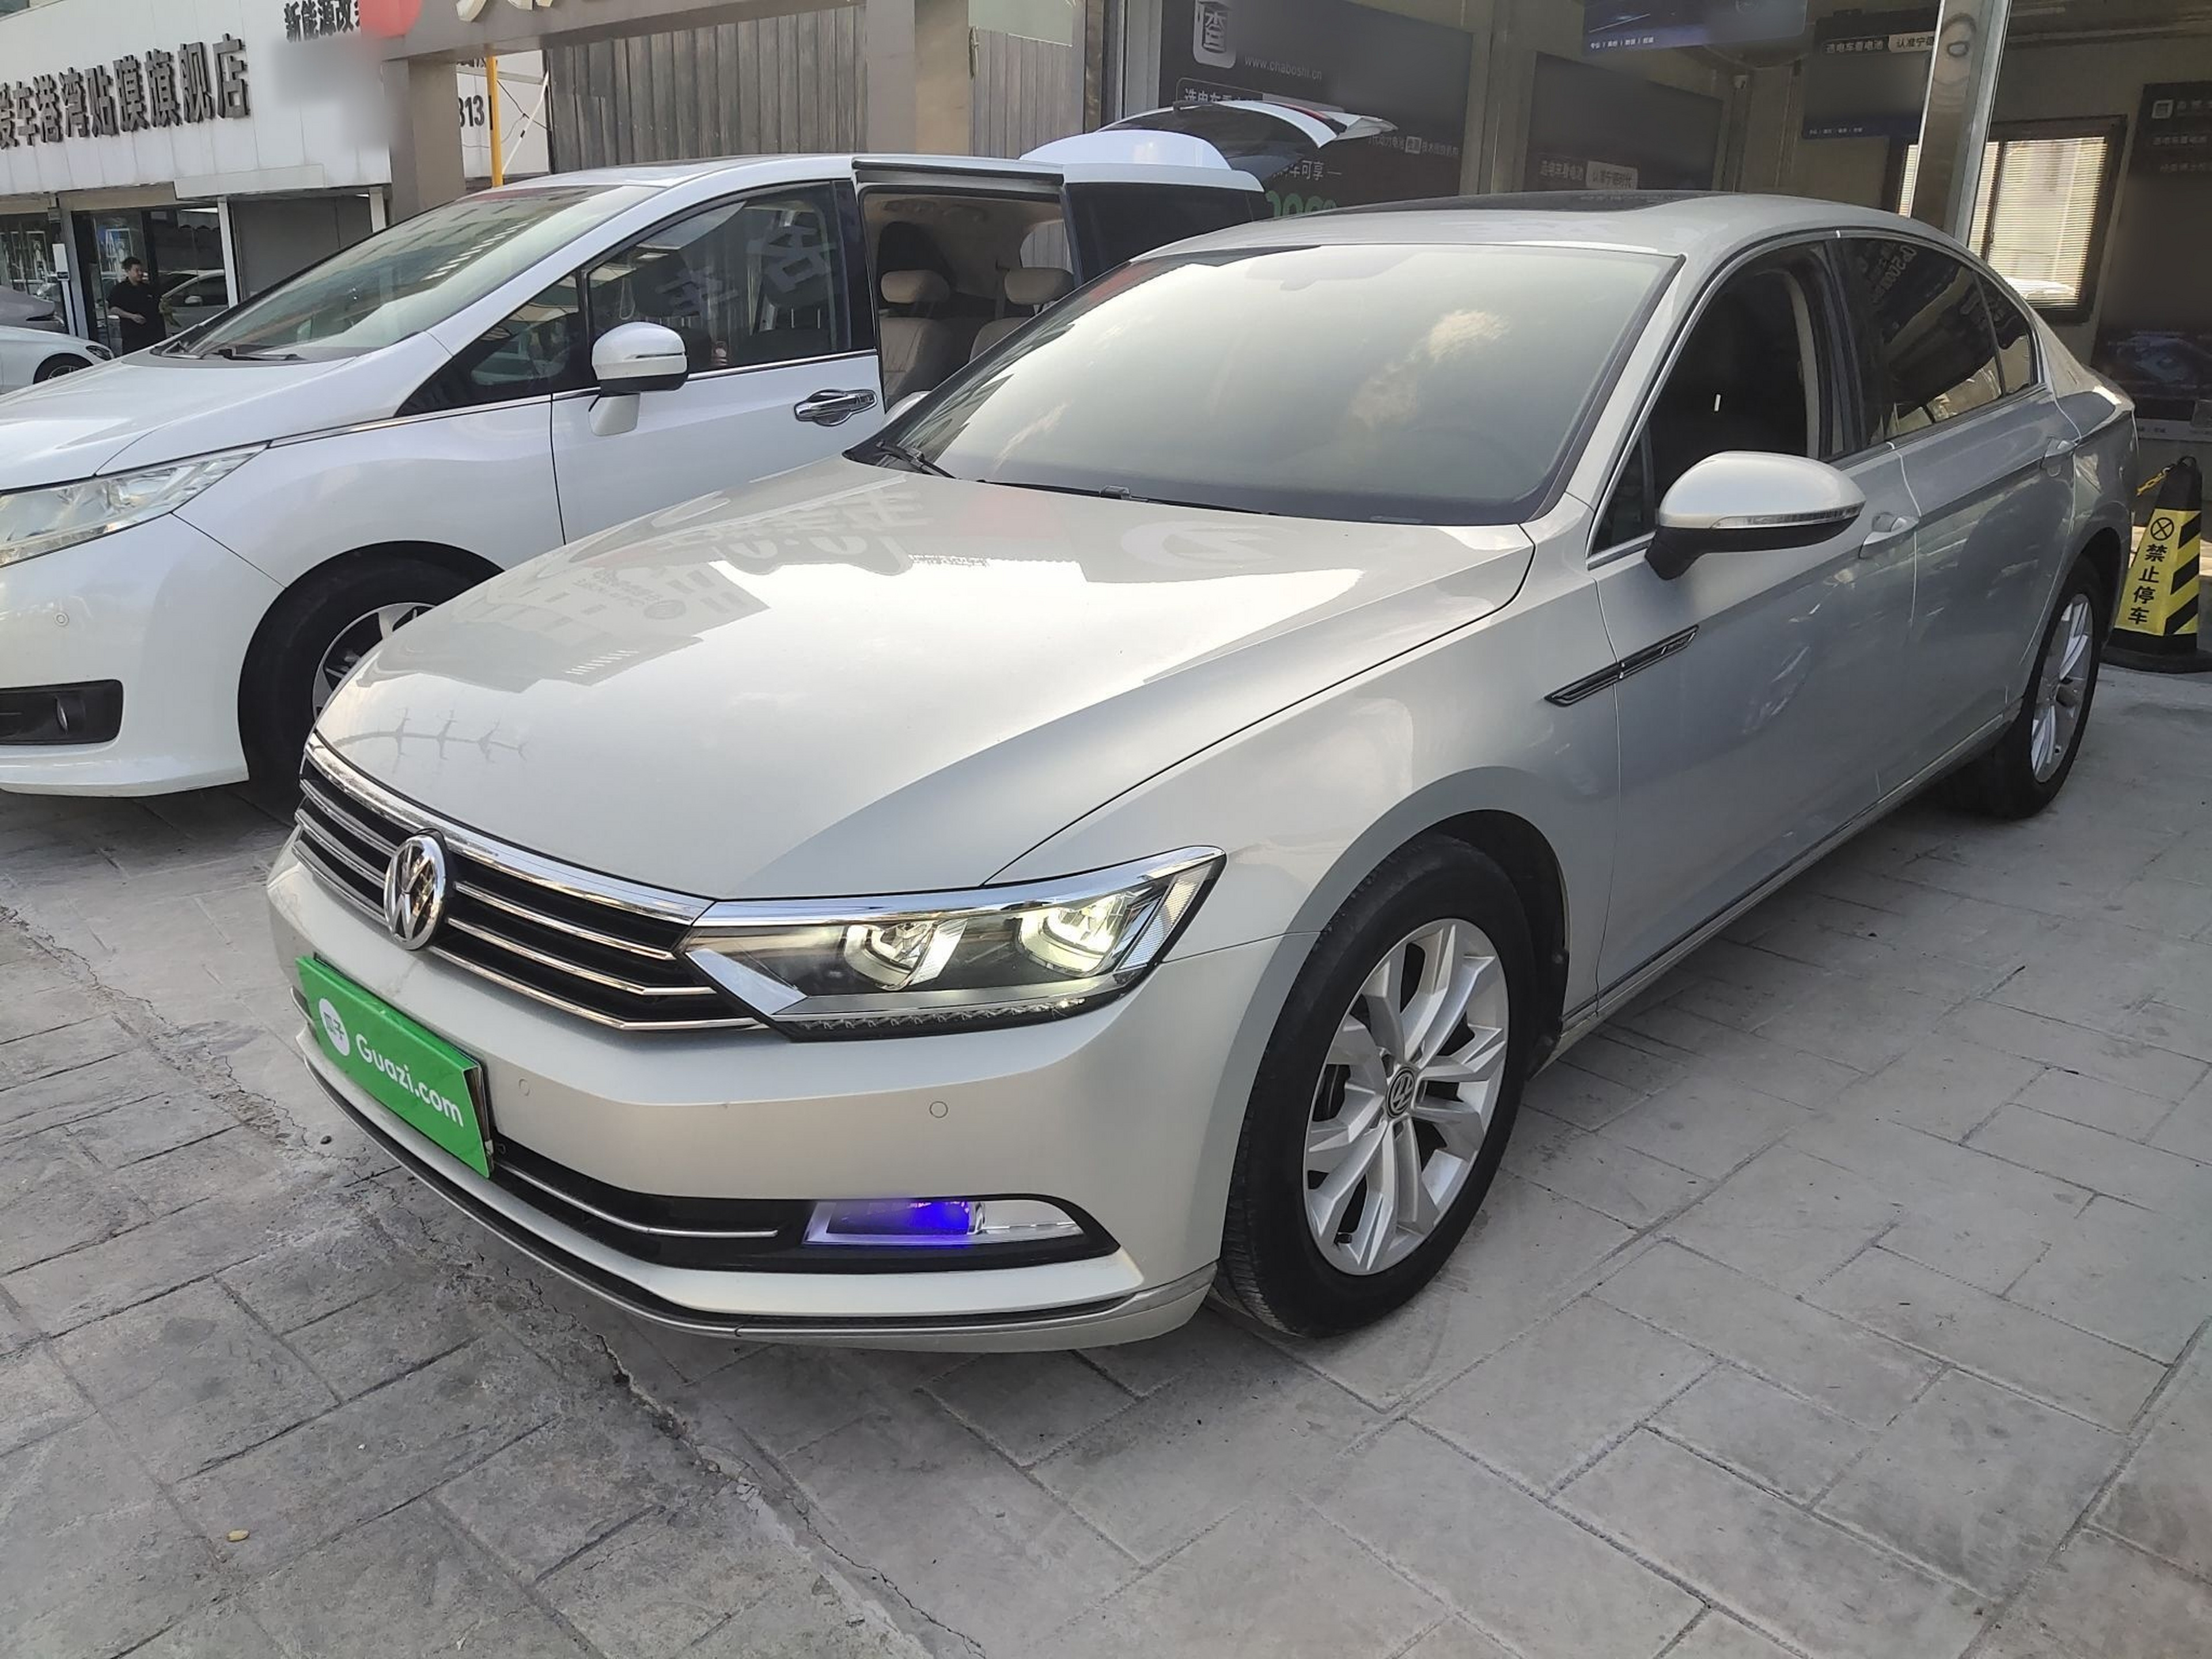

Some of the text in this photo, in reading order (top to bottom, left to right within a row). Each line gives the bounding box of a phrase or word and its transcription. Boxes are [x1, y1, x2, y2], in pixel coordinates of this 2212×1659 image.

[283, 0, 361, 43] 新能源改
[1244, 55, 1323, 81] www.chaboshi.cn
[2128, 543, 2168, 625] 禁止停车
[355, 1033, 464, 1128] Guazi.com
